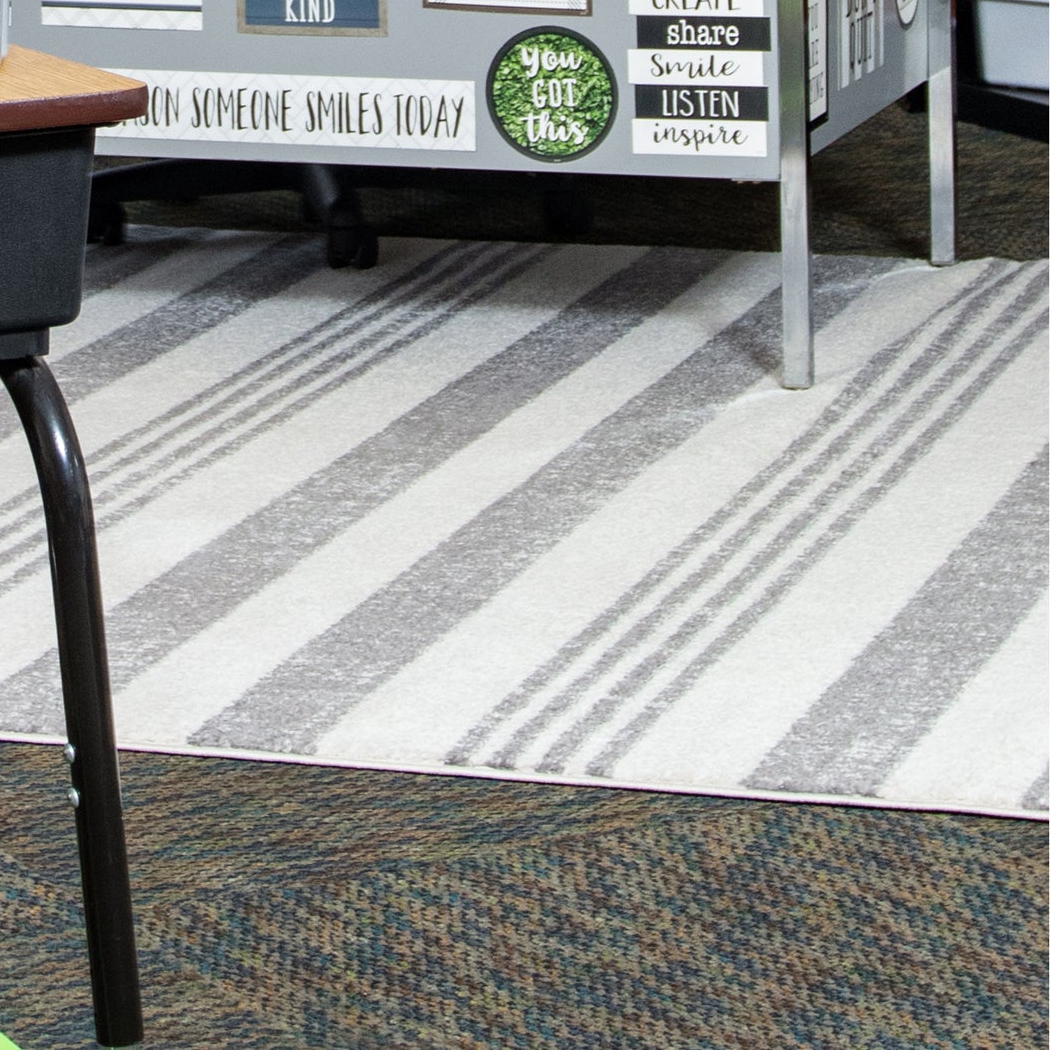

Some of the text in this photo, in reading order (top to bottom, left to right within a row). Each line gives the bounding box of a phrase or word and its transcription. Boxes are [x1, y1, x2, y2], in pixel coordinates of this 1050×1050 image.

[667, 19, 739, 46] share
[650, 53, 741, 79] Smile
[532, 78, 577, 108] GOT
[662, 89, 740, 118] LISTEN
[121, 85, 465, 139] ON SOMEONE SMILES TODAY
[519, 111, 590, 145] this
[653, 122, 749, 152] inspire
